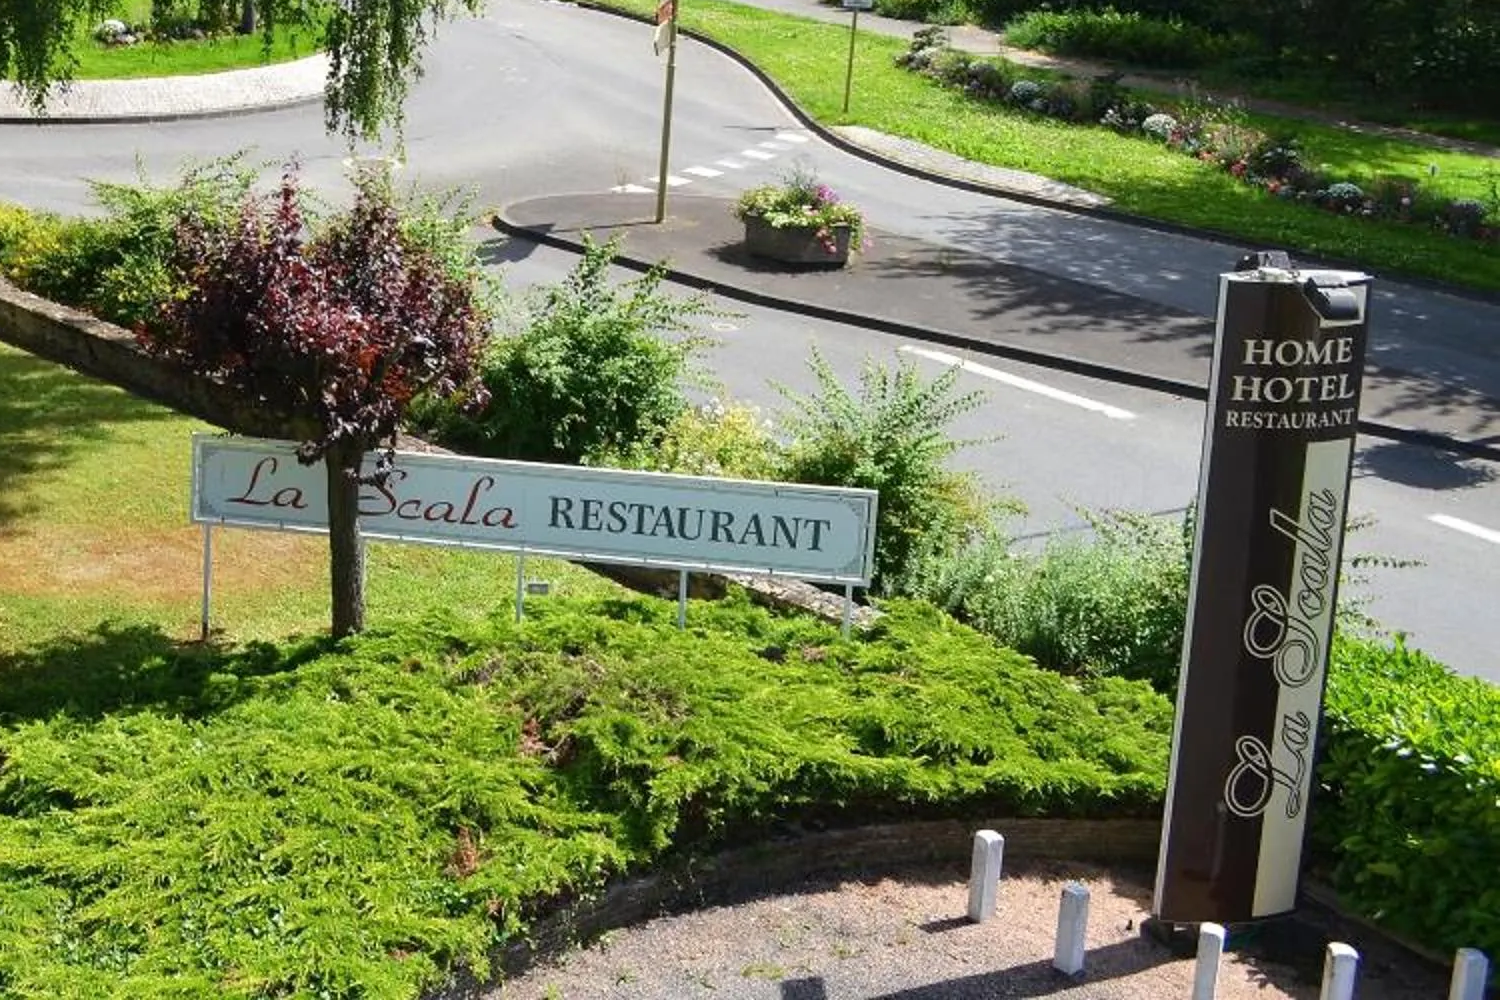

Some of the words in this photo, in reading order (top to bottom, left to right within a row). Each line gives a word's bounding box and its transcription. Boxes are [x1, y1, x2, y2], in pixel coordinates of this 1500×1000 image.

[1241, 337, 1353, 367] HOME
[1225, 407, 1355, 430] RESTAURANT
[1230, 373, 1355, 403] HOTEL
[224, 456, 309, 510] La
[357, 468, 518, 529] Scala
[547, 495, 831, 552] RESTAURANT
[1243, 487, 1338, 688] Scala
[1224, 711, 1312, 818] La
